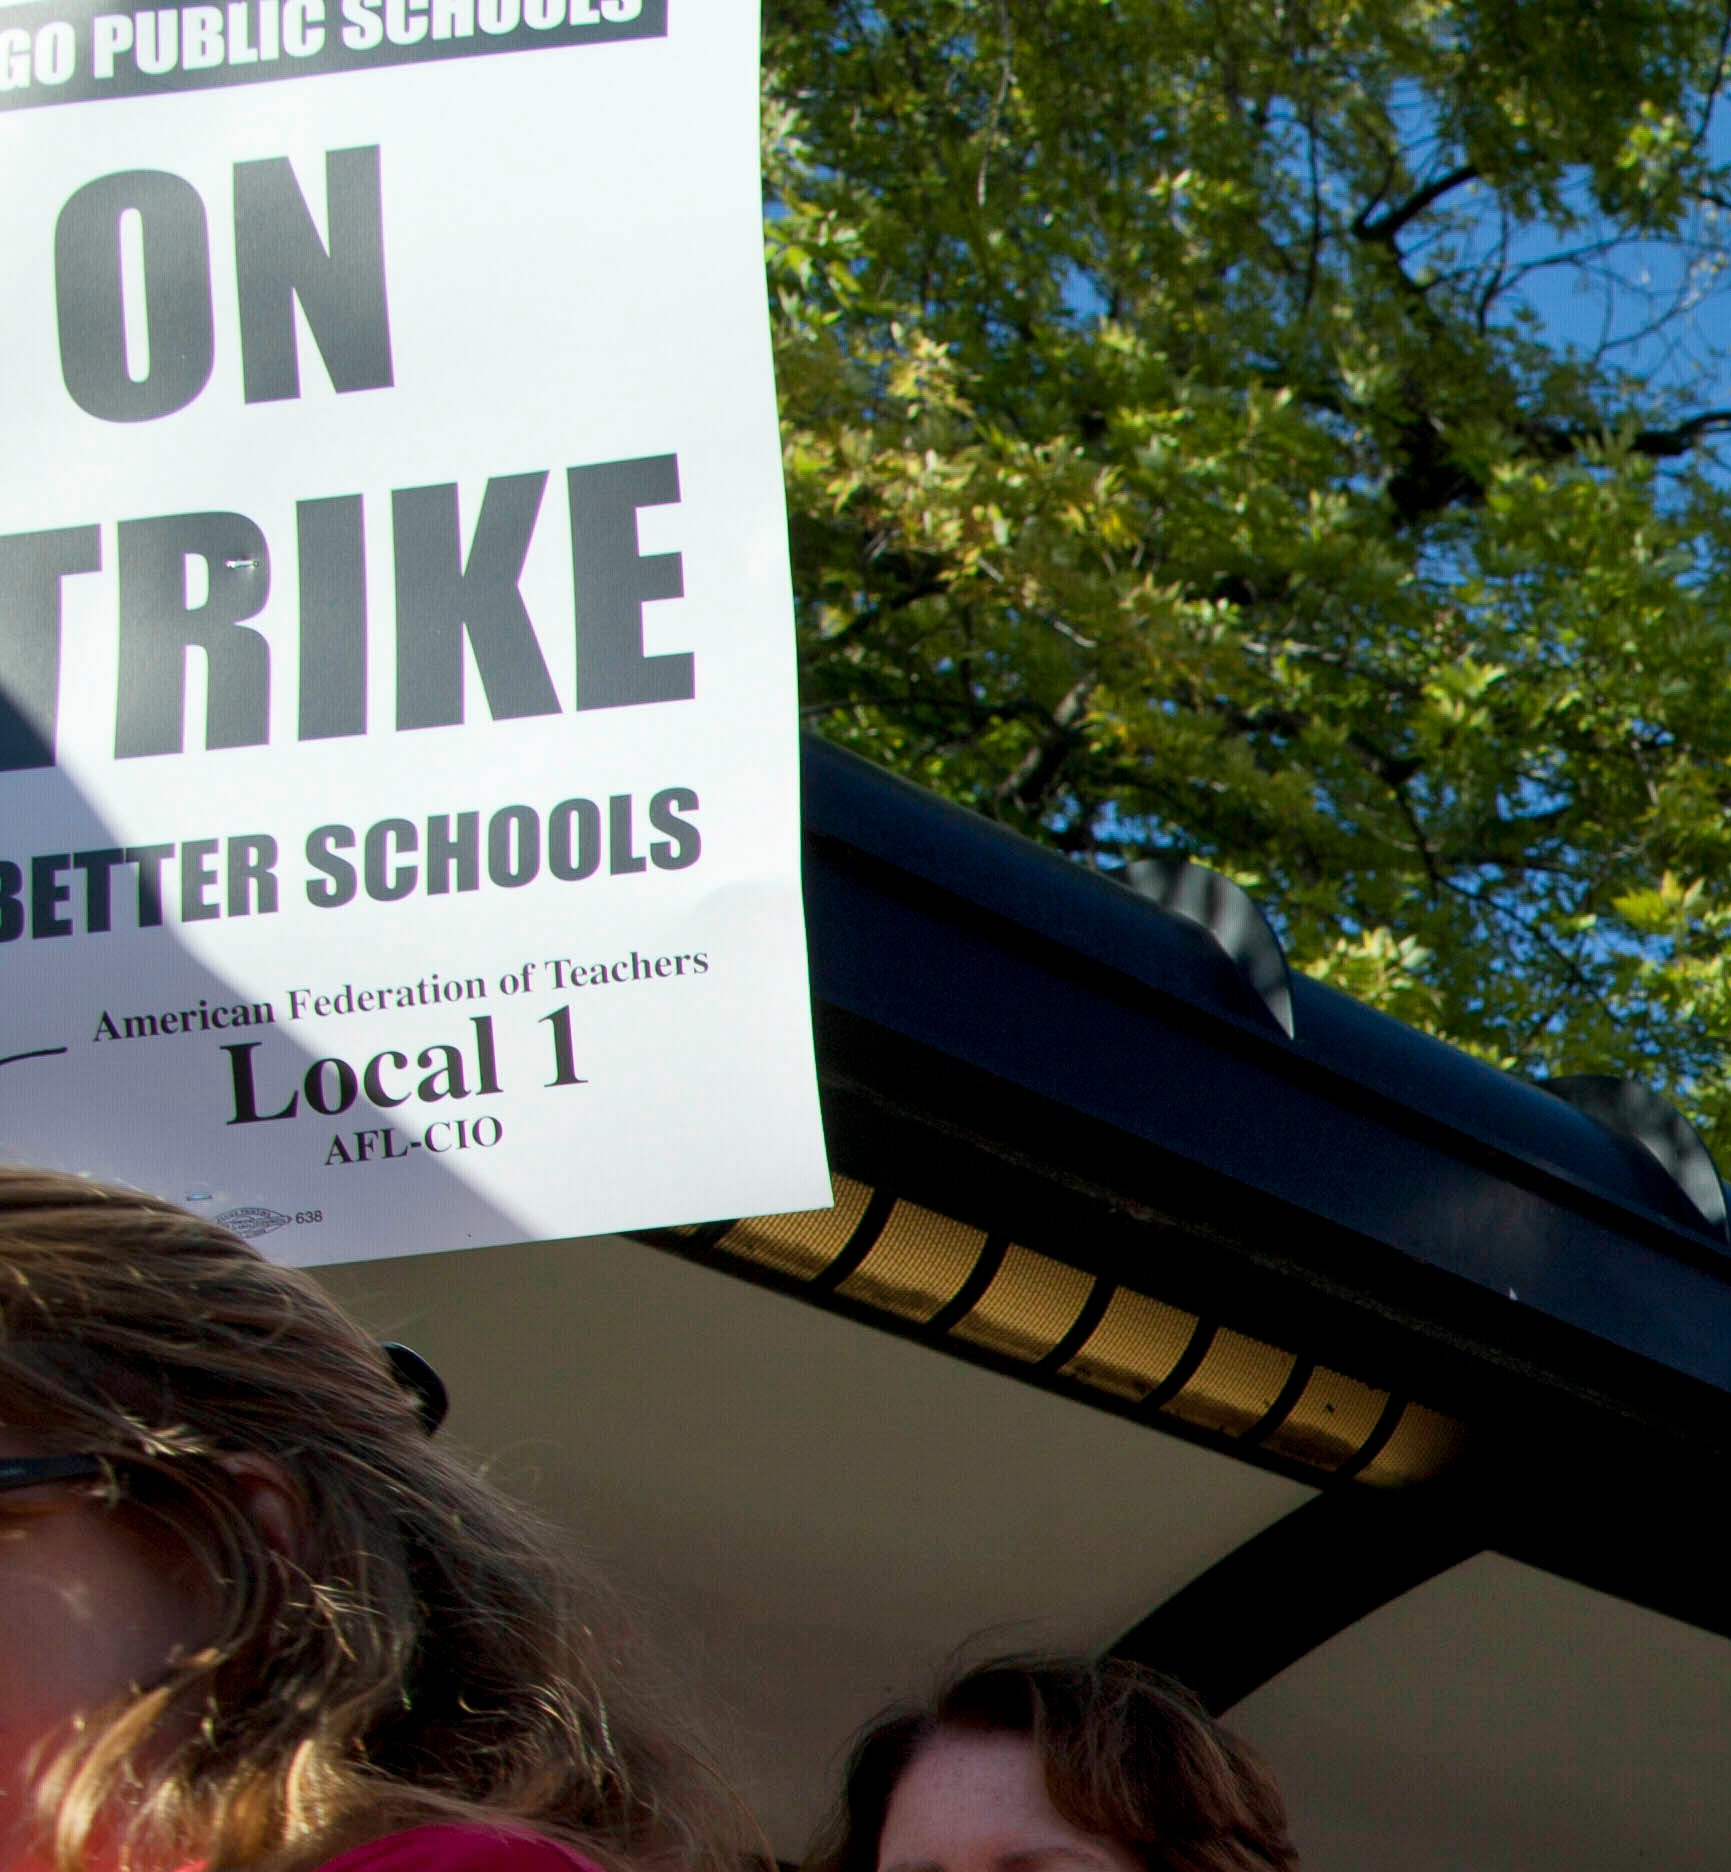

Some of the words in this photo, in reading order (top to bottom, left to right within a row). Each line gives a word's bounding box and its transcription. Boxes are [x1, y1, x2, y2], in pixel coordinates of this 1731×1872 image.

[93, 0, 326, 80] PUBLIC
[54, 143, 395, 424] ON
[304, 787, 702, 909] SCHOOLS
[92, 1000, 275, 1043] American
[289, 973, 487, 1021] Federation
[499, 962, 536, 996] of
[545, 951, 710, 990] Teachers
[220, 1016, 504, 1126] Local
[538, 1005, 589, 1089] 1
[324, 1115, 504, 1167] AFL-CIO
[295, 1210, 323, 1225] 638
